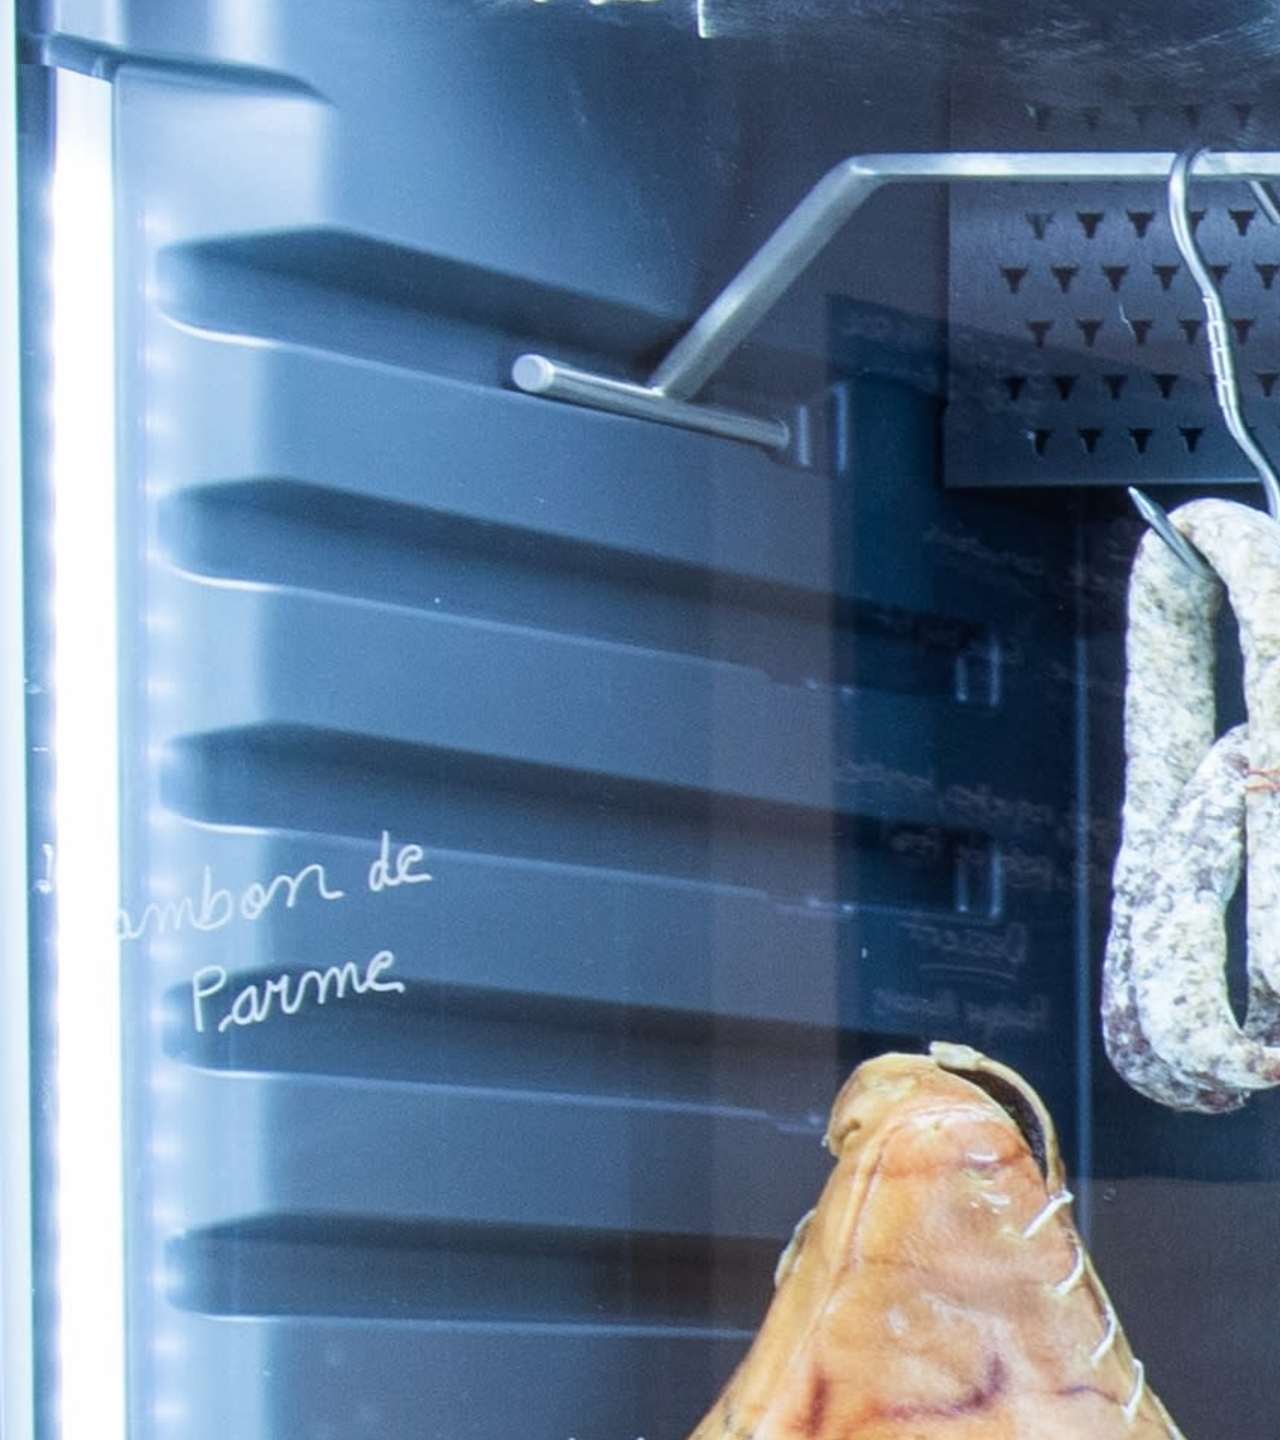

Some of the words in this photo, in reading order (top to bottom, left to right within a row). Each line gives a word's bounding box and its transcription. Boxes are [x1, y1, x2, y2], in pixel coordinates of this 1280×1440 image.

[75, 854, 345, 942] ambon
[368, 830, 432, 893] de
[191, 950, 405, 1033] Parme
